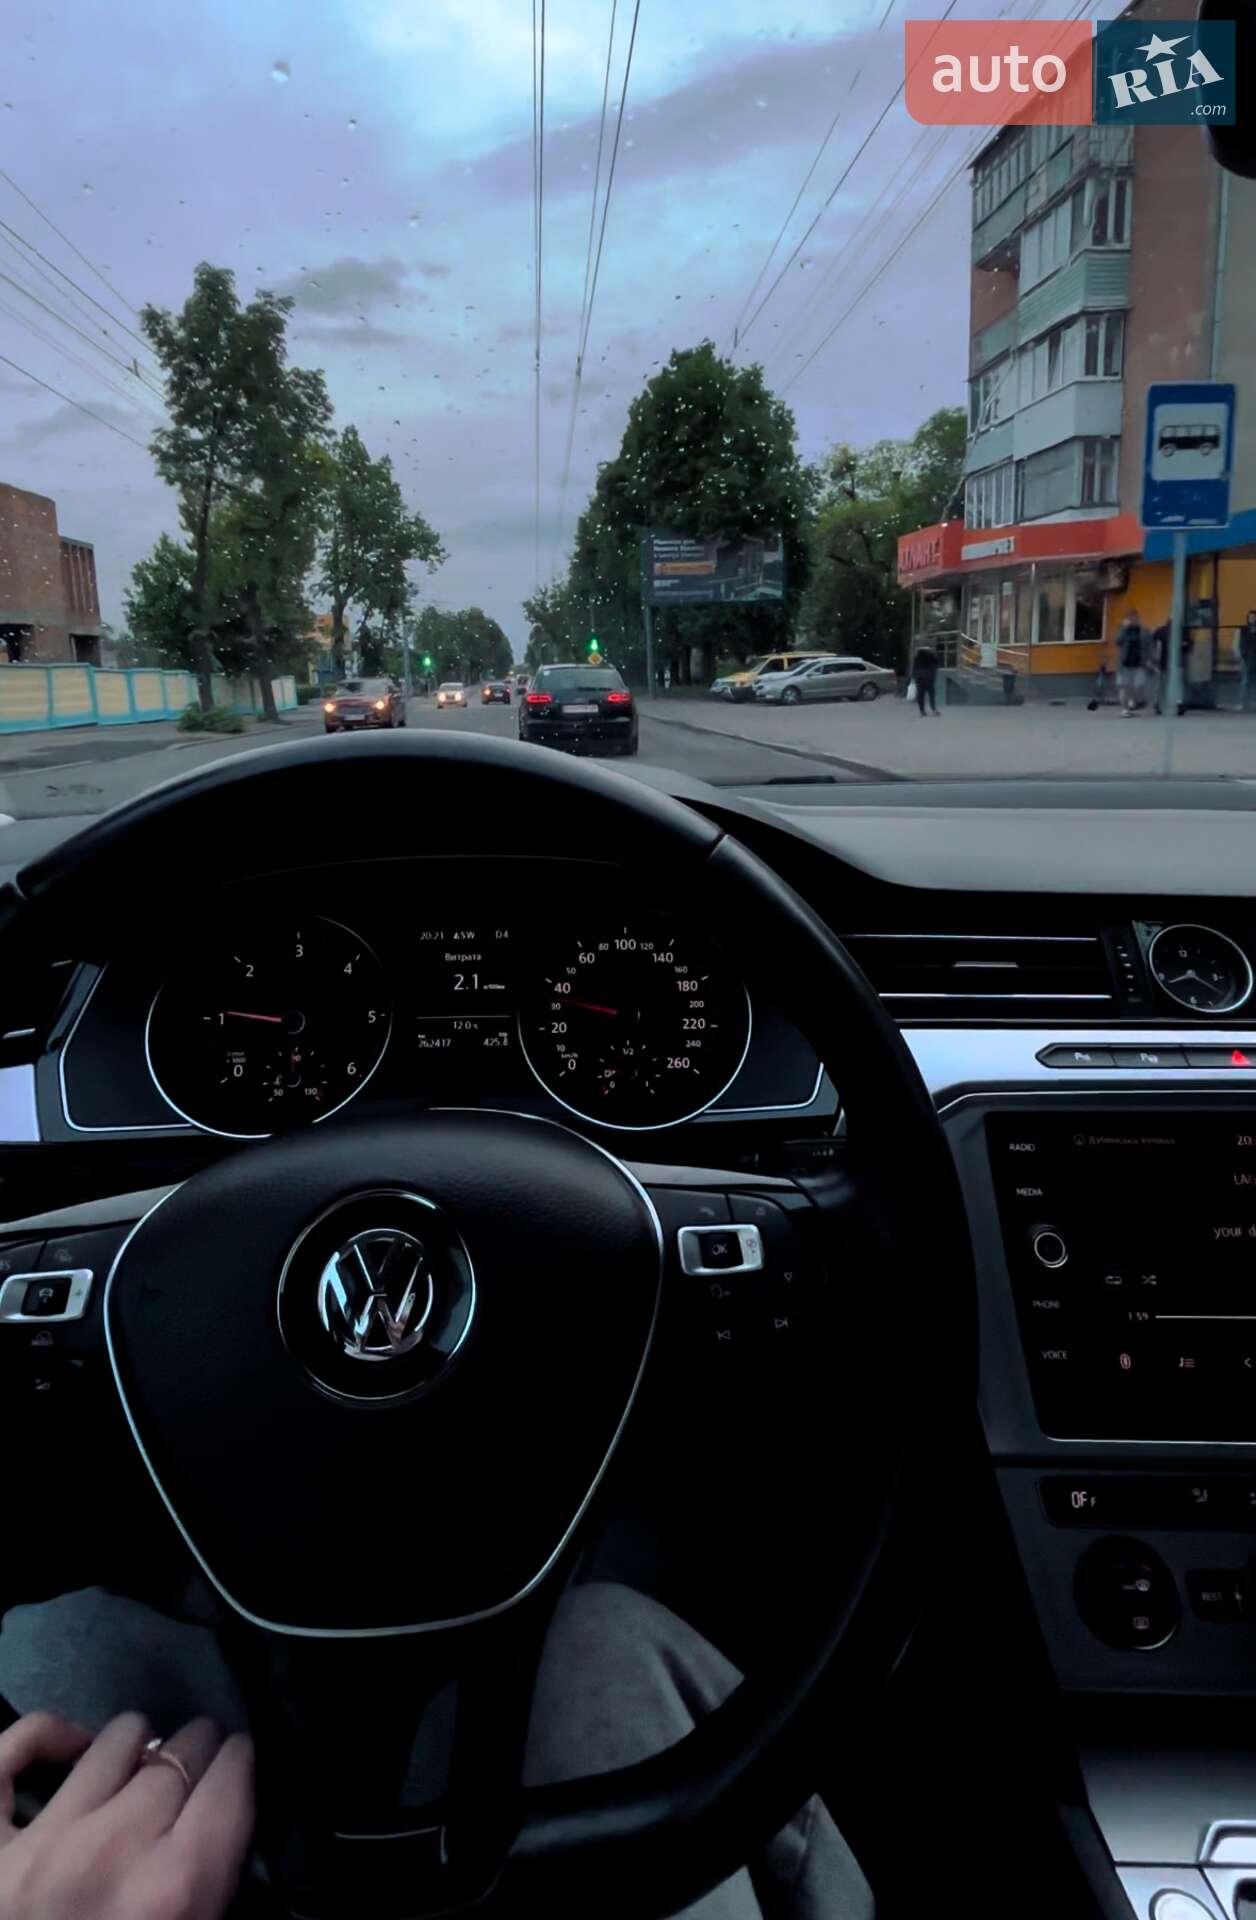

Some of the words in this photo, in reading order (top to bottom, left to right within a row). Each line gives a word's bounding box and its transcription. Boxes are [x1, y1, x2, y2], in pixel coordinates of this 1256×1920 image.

[295, 943, 304, 958] 3
[598, 942, 610, 951] 80
[613, 938, 637, 951] 100
[639, 942, 655, 951] 120
[578, 952, 596, 964] 60
[652, 952, 674, 964] 140
[245, 964, 255, 978] 2
[343, 962, 353, 975] 4
[565, 966, 577, 975] 50
[673, 965, 689, 974] 160
[453, 973, 479, 991] 2.1
[554, 981, 572, 994] 40
[676, 979, 699, 992] 180
[551, 1001, 562, 1011] 30
[688, 1000, 705, 1009] 200
[218, 1012, 225, 1026] 1
[368, 1009, 377, 1024] 5
[551, 1021, 568, 1034] 20
[681, 1017, 706, 1030] 220
[556, 1043, 566, 1053] 10
[685, 1039, 702, 1048] 240
[346, 1061, 357, 1076] 6
[567, 1058, 577, 1071] 0
[666, 1056, 691, 1069] 260
[233, 1063, 244, 1078] 0
[1008, 1142, 1036, 1152] RADIO
[1015, 1187, 1044, 1197] MEDIA
[711, 1243, 728, 1256] OK
[1032, 1299, 1060, 1310] PHONE
[1041, 1350, 1068, 1360] VOICE
[1070, 1490, 1096, 1509] OFF
